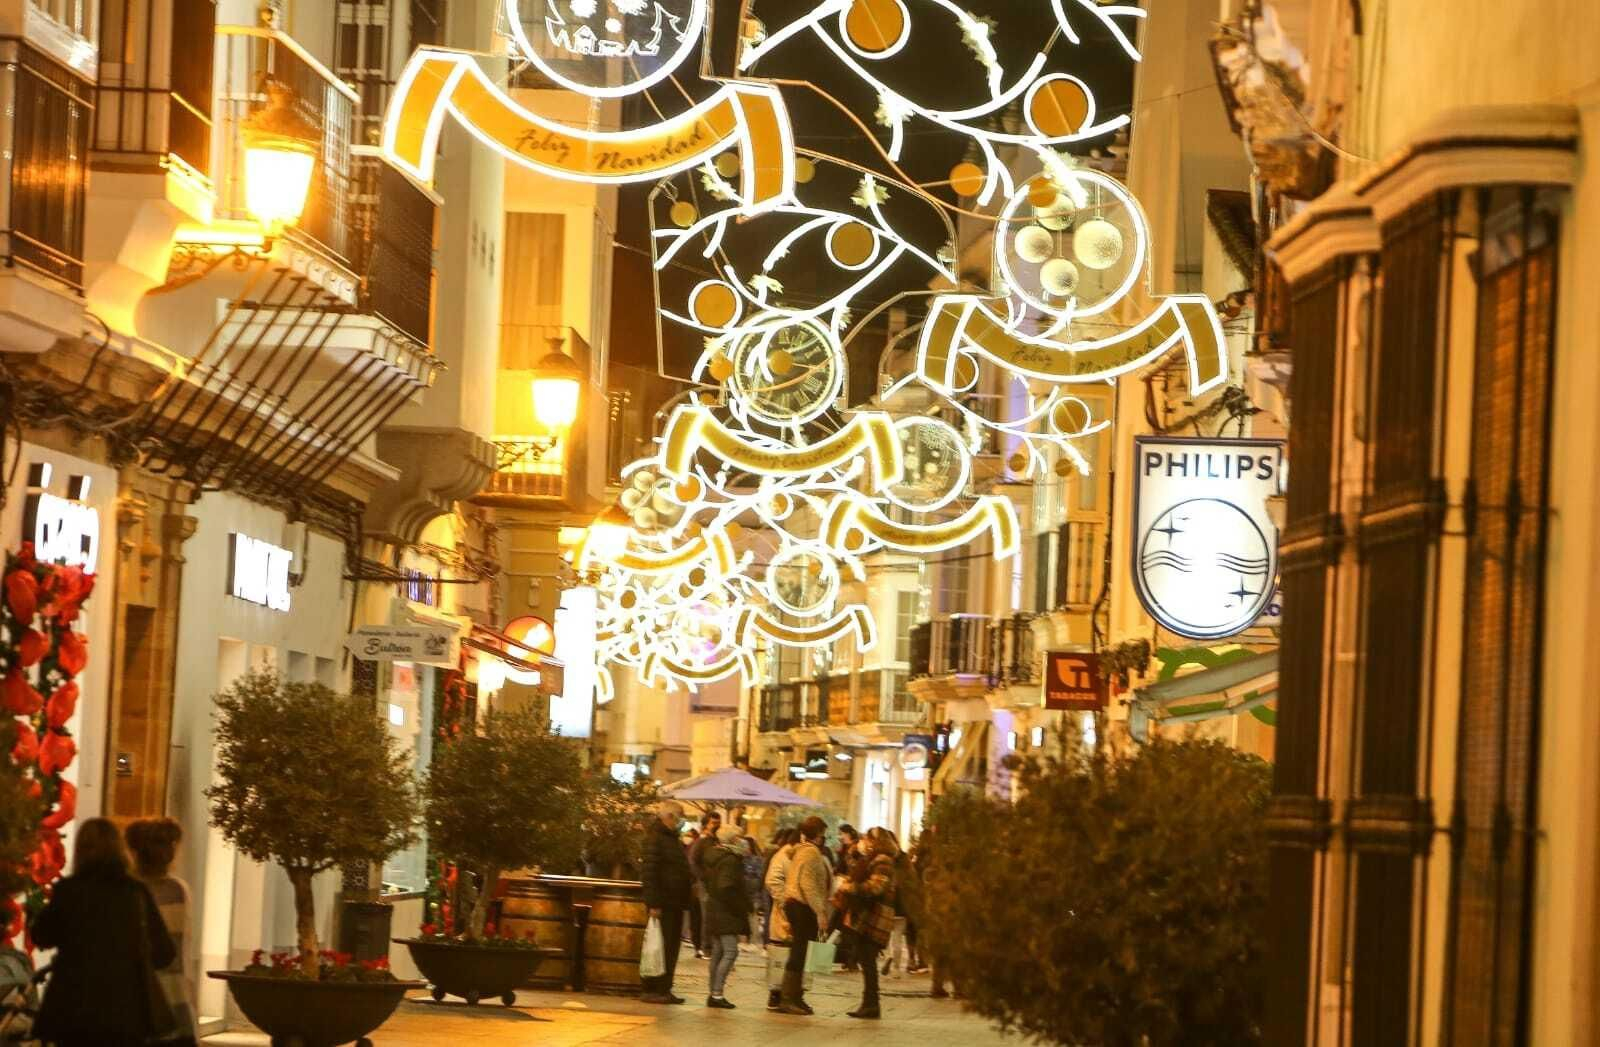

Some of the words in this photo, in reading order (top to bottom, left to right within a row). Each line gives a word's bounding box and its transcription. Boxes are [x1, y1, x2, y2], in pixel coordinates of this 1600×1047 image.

[515, 128, 570, 162] Feliz
[594, 120, 704, 169] Navidad
[1145, 452, 1273, 480] PHILIPS
